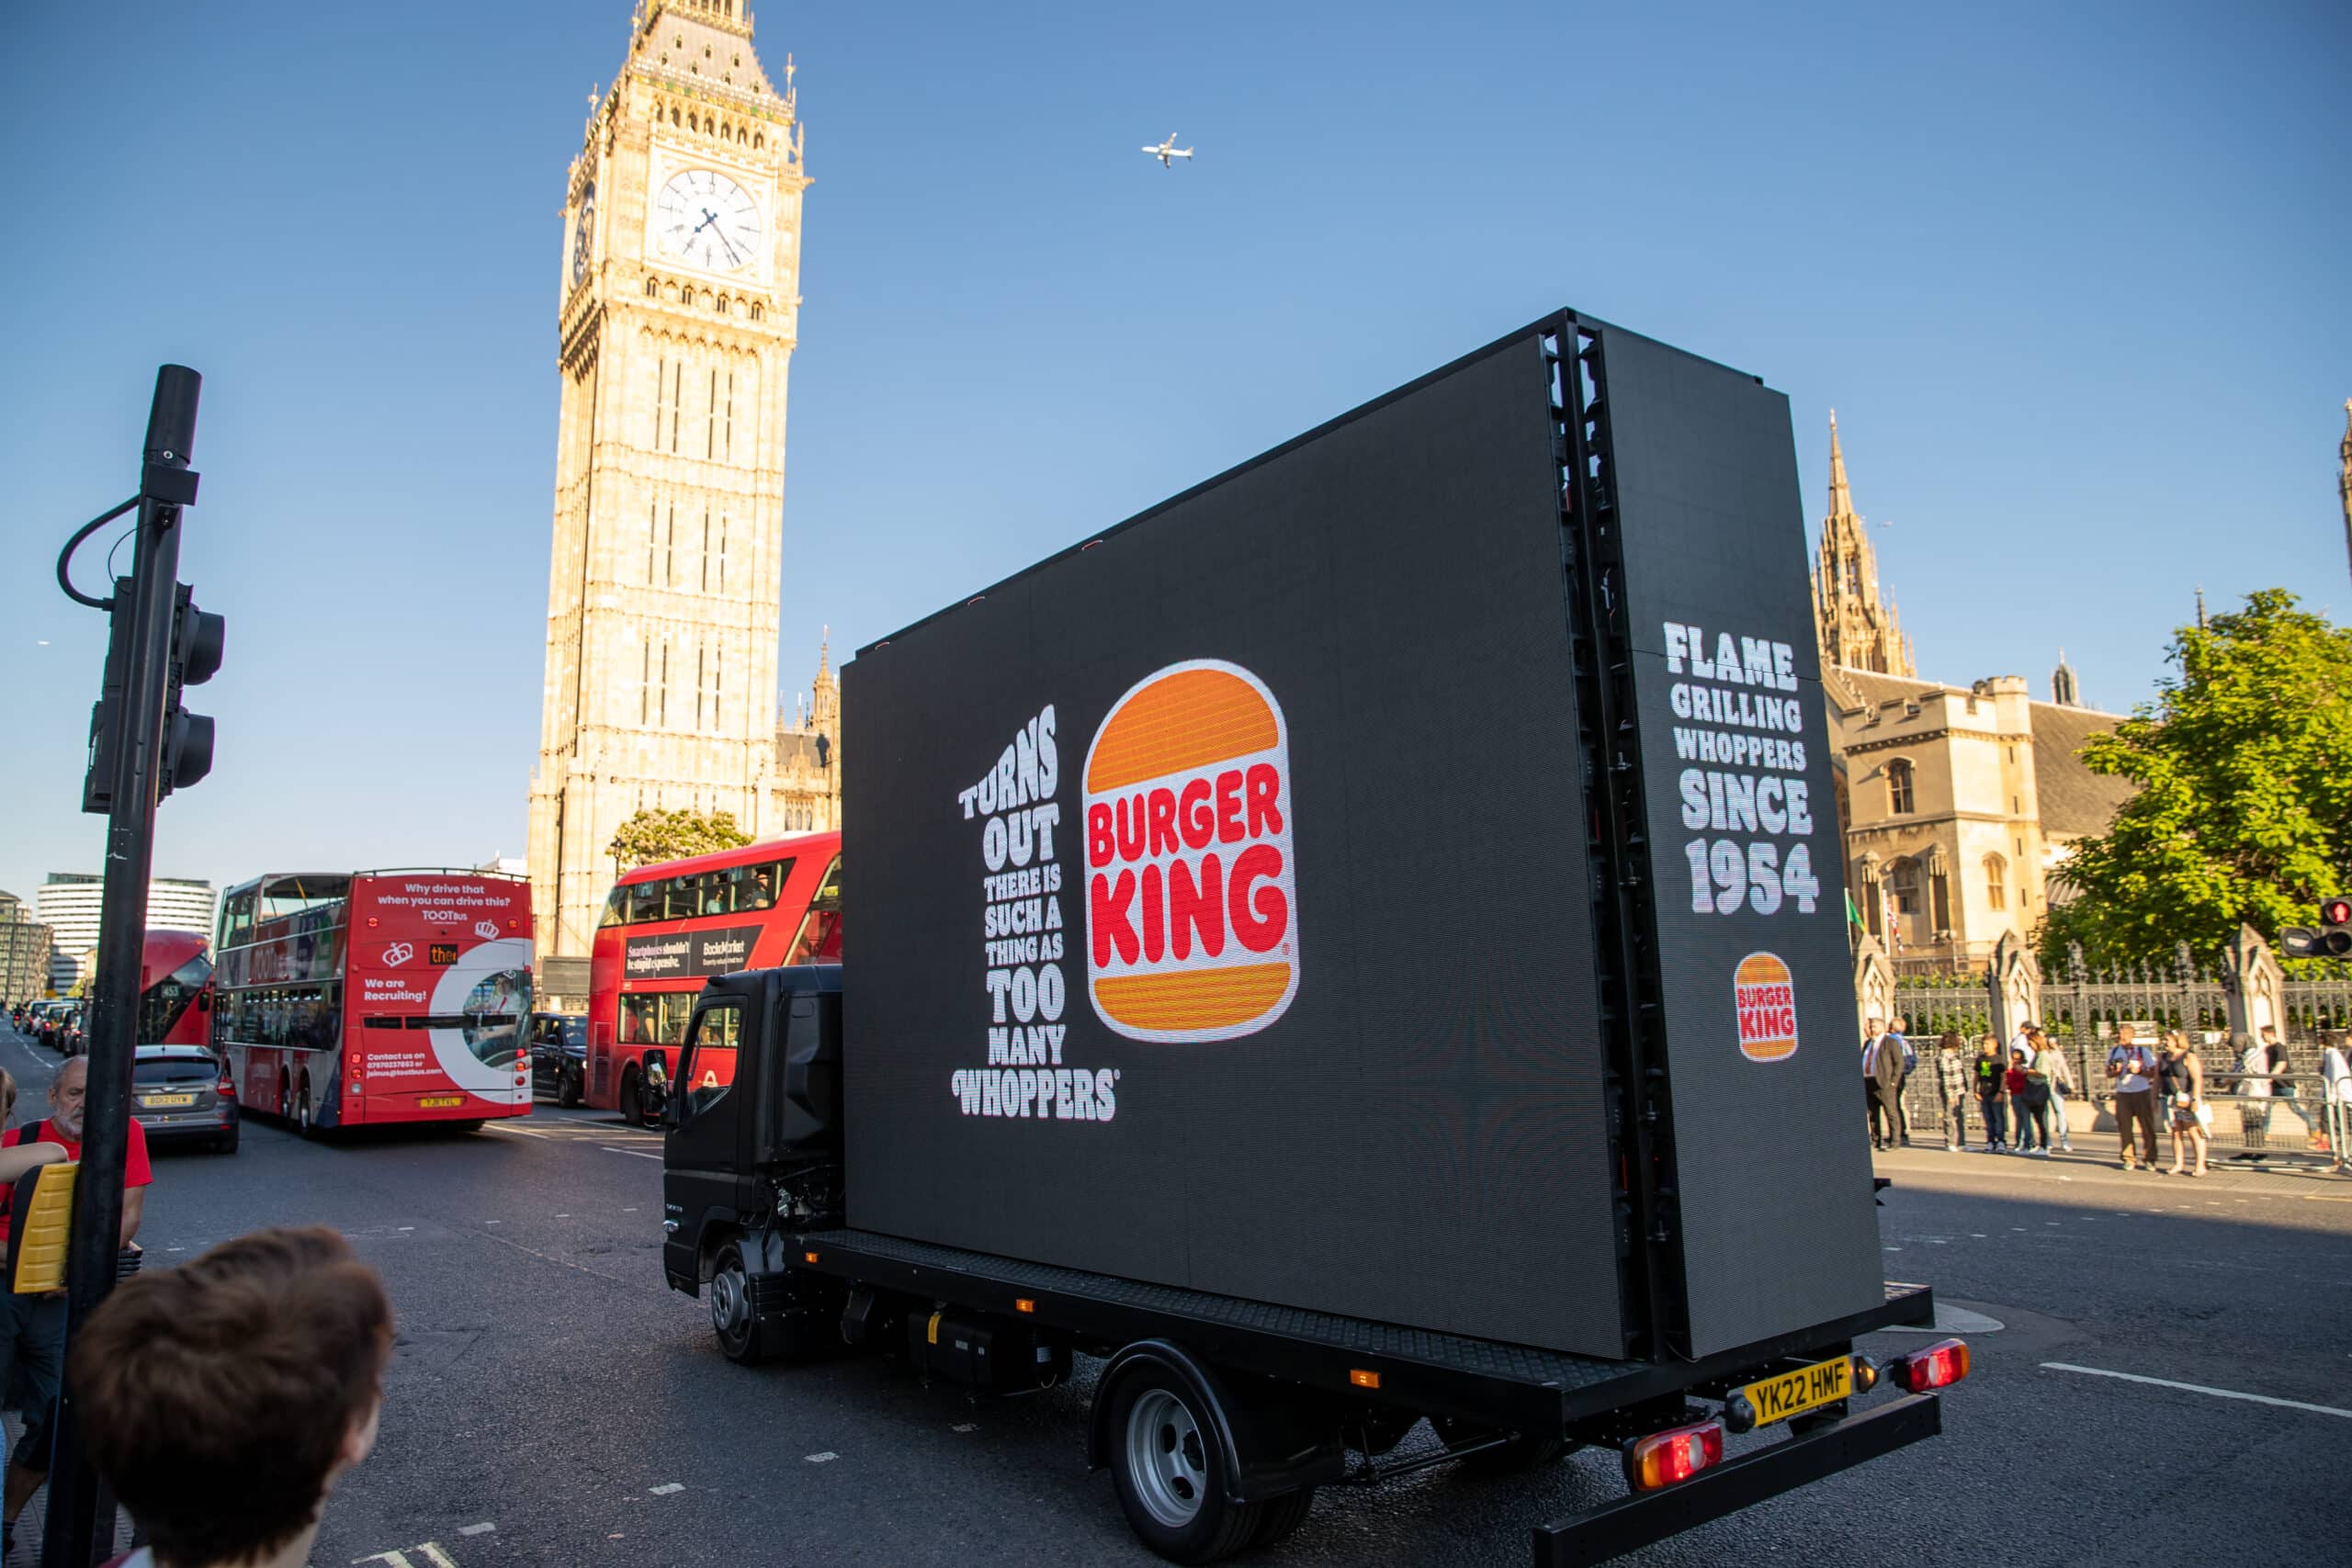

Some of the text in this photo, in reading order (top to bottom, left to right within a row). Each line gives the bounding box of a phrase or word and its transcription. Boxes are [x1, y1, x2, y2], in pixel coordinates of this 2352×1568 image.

[1663, 621, 1798, 693] FLAME
[1670, 682, 1804, 734] GRILLING
[958, 703, 1058, 820] TURNS
[1673, 726, 1807, 773] WHOPPERS
[1087, 762, 1283, 868] BURGER
[1679, 768, 1814, 836] SINCE
[983, 802, 1060, 873] OUT
[405, 883, 485, 895] Why drive that
[984, 863, 1062, 903] THERE IS
[1685, 837, 1820, 916] 1954
[378, 896, 511, 907] when you can drive this?
[985, 895, 1063, 939] SUCH A
[1091, 843, 1288, 969] KING
[985, 932, 1064, 967] THING AS
[162, 985, 179, 997] 453
[364, 990, 427, 1003] Recruiting!
[365, 978, 405, 988] We are
[986, 963, 1066, 1023] TOO
[1736, 986, 1792, 1009] BURGER
[988, 1023, 1067, 1066] MANY
[1739, 1008, 1794, 1039] KING
[1757, 1361, 1845, 1418] YK22 HMF
